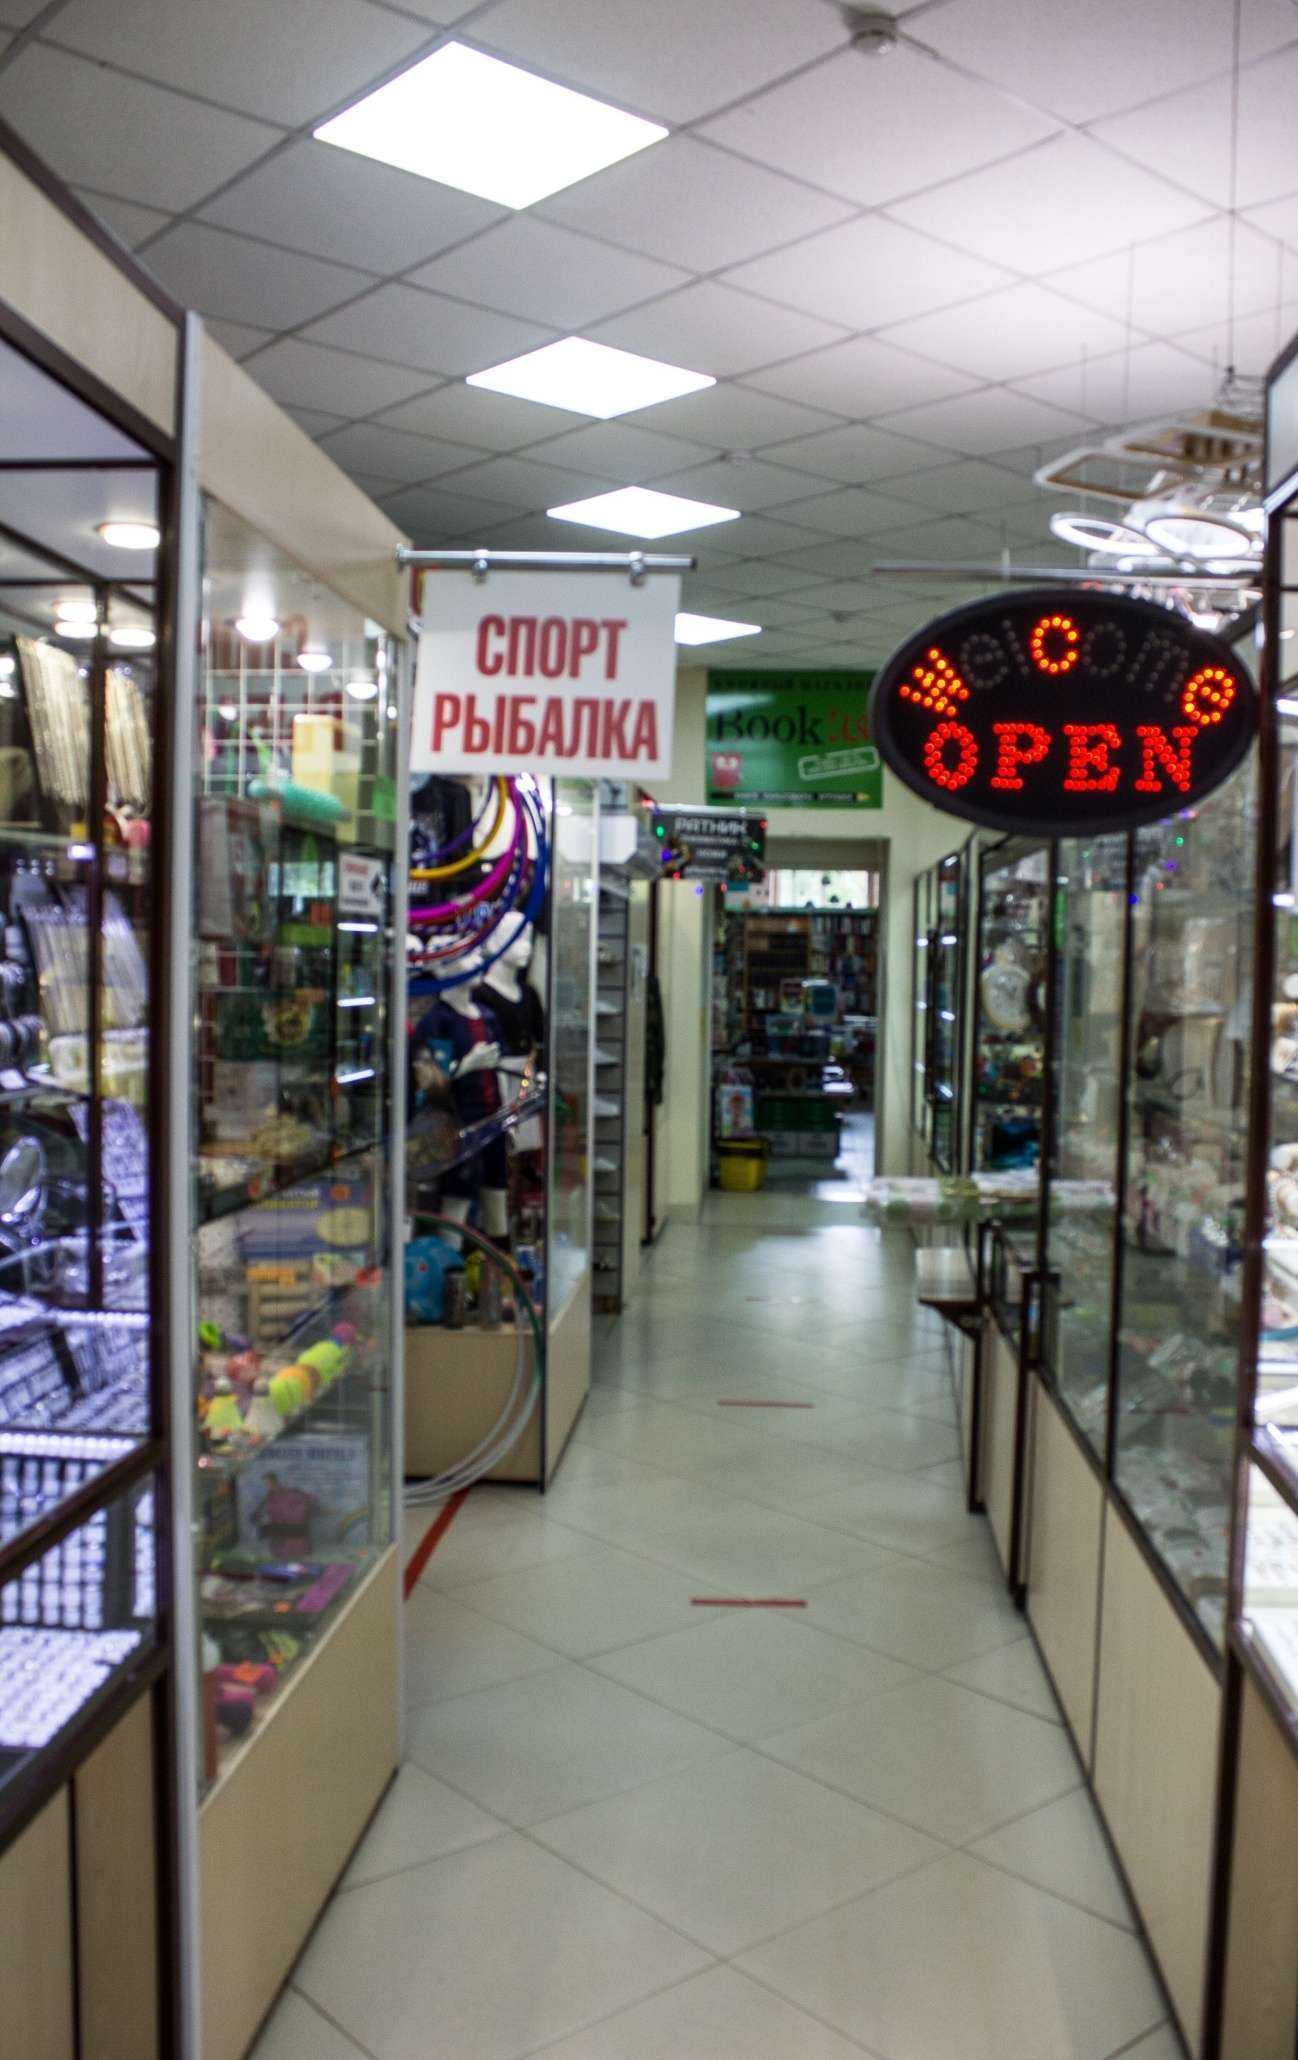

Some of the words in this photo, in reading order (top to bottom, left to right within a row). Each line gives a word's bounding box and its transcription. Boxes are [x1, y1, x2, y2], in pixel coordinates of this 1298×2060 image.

[475, 613, 629, 681] СПОРТ
[430, 692, 660, 763] РЫБАЛКА
[923, 721, 1200, 792] OPEN
